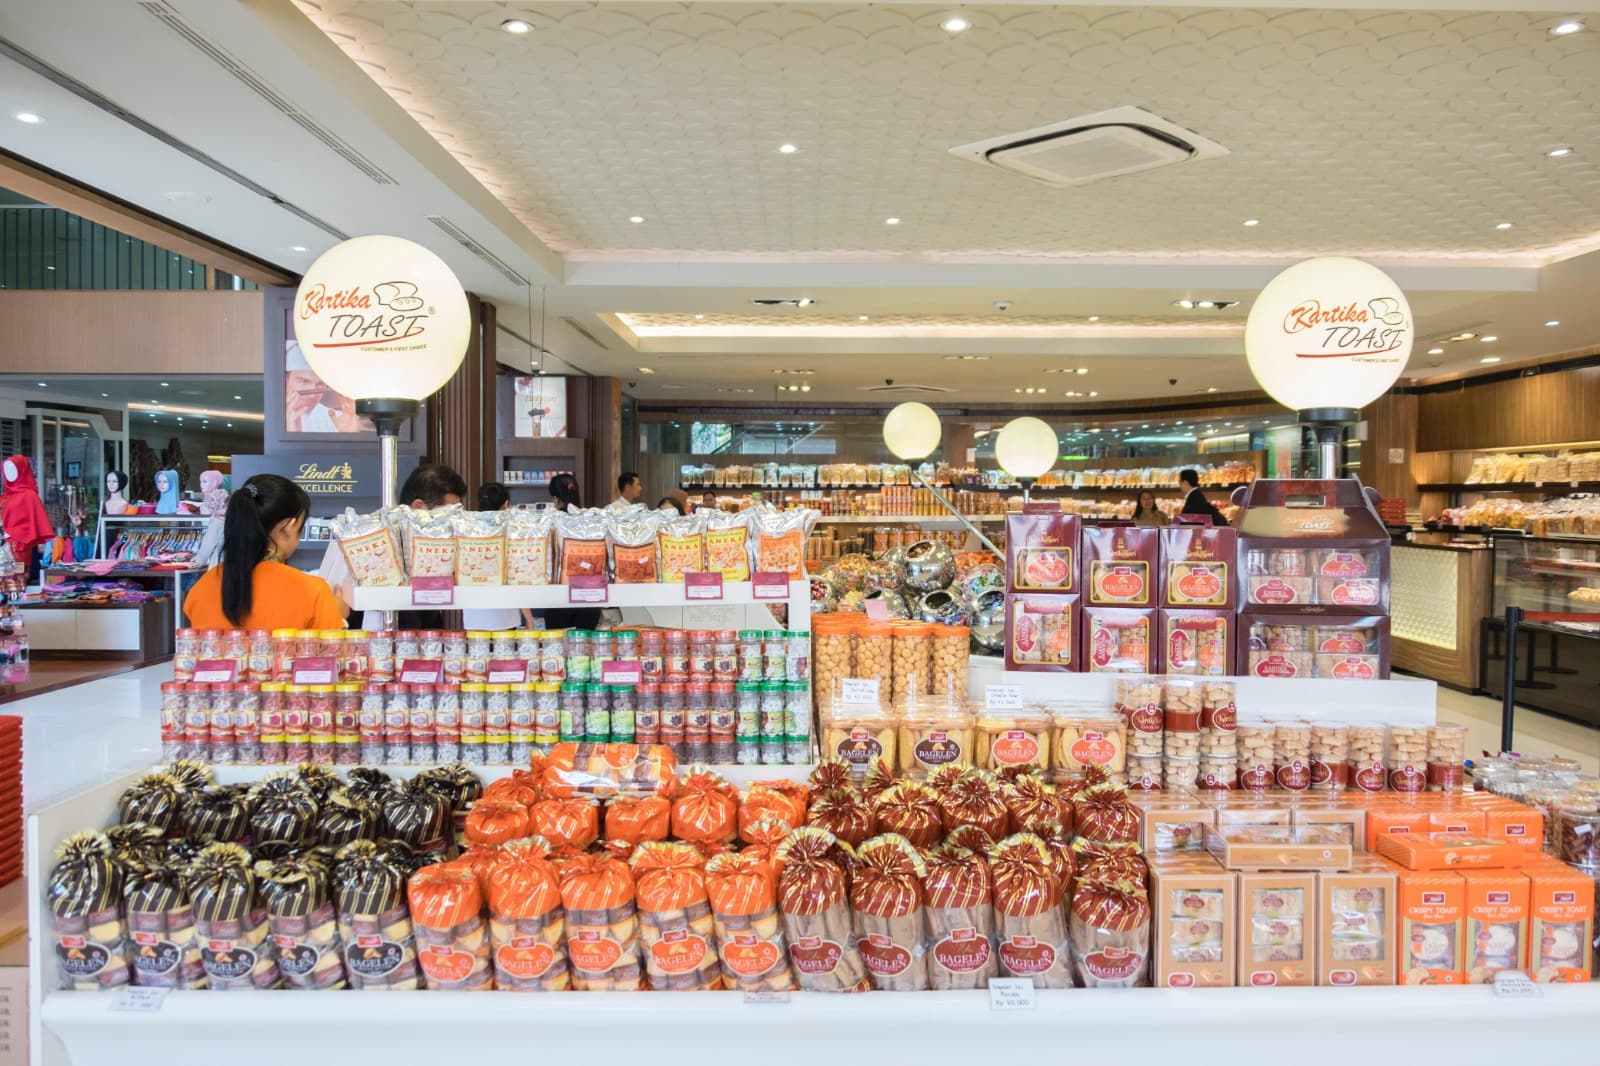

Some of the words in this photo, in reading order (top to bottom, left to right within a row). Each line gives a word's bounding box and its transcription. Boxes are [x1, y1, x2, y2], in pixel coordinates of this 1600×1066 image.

[302, 284, 371, 318] Kartika
[1285, 300, 1368, 332] Kartika
[329, 314, 428, 338] TOAST
[1322, 326, 1405, 350] TOAST
[295, 463, 341, 480] Lindt
[301, 484, 353, 493] XCELLENCE
[709, 535, 742, 545] ANEKA
[349, 539, 387, 556] ANEKA
[663, 543, 698, 551] ANEKA
[840, 748, 879, 758] BAGELEN
[919, 750, 957, 758] BAGELEN
[997, 748, 1035, 757] BAGELEN
[1074, 750, 1113, 759] BAGELEN
[1436, 906, 1458, 914] TOAST
[1500, 906, 1522, 914] TOAST
[1566, 906, 1587, 914] TOAST
[501, 955, 550, 970] BAGELEN
[655, 950, 704, 966] BAGELEN
[727, 955, 775, 968] BAGELEN
[939, 950, 989, 964] BAGELEN
[1003, 953, 1053, 968] BAGELEN
